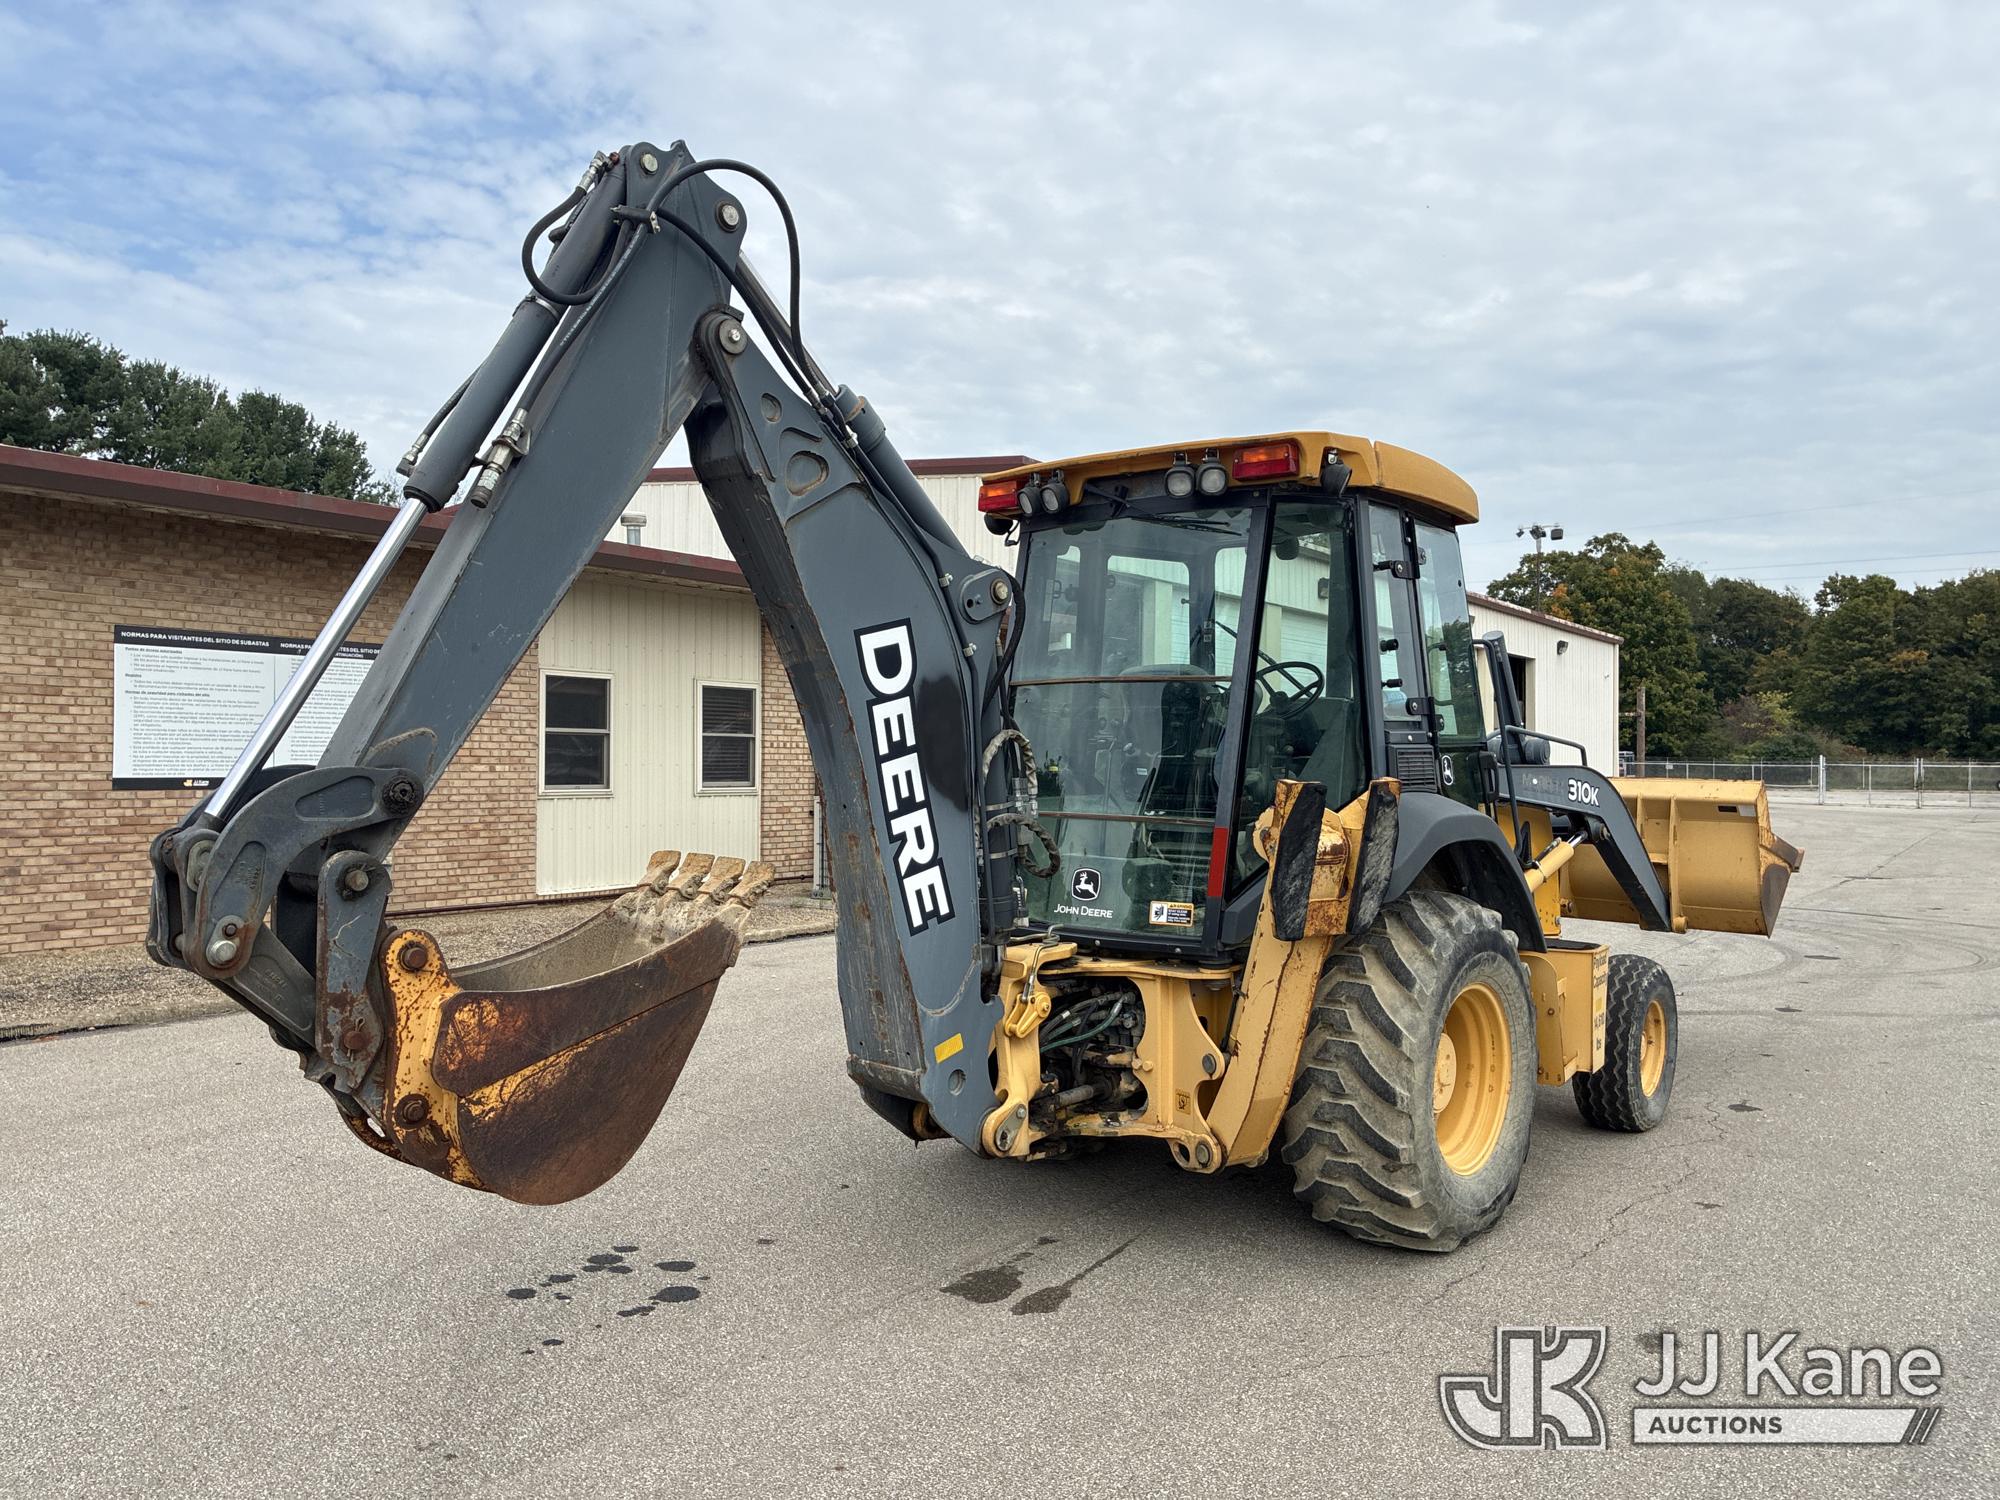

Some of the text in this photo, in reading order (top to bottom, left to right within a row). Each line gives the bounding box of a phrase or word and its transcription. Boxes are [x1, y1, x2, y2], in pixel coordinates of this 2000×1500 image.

[121, 631, 149, 639] NORMAS
[167, 634, 202, 642] VISITANTES
[203, 636, 216, 644] DEL
[240, 639, 270, 647] SUBASTAS
[857, 622, 952, 930] DEERE
[1567, 777, 1600, 807] 310K
[1053, 903, 1114, 919] JOHN DEERE
